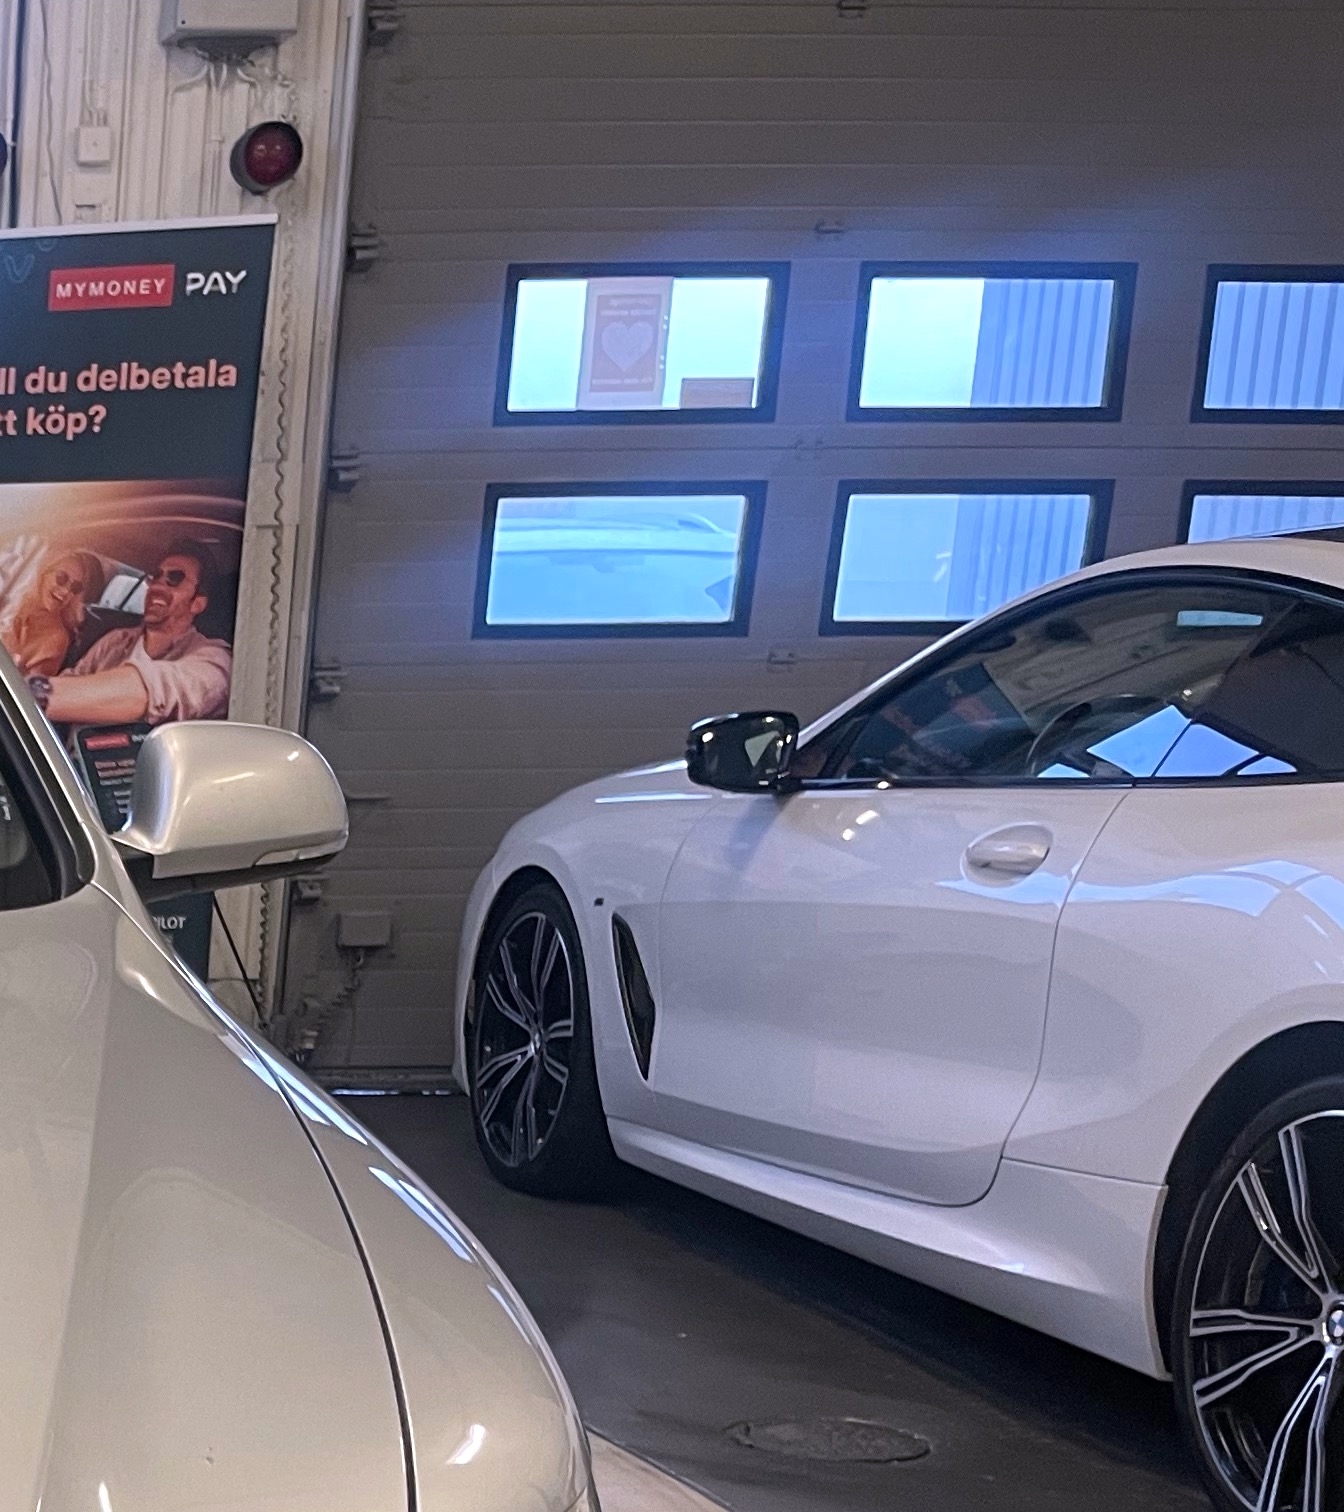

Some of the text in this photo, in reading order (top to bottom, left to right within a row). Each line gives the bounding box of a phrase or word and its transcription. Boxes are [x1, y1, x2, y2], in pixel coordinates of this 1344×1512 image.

[55, 270, 248, 299] MYMONEY PAY
[24, 365, 67, 394] du
[76, 358, 238, 393] delbetala
[25, 404, 107, 441] köp?
